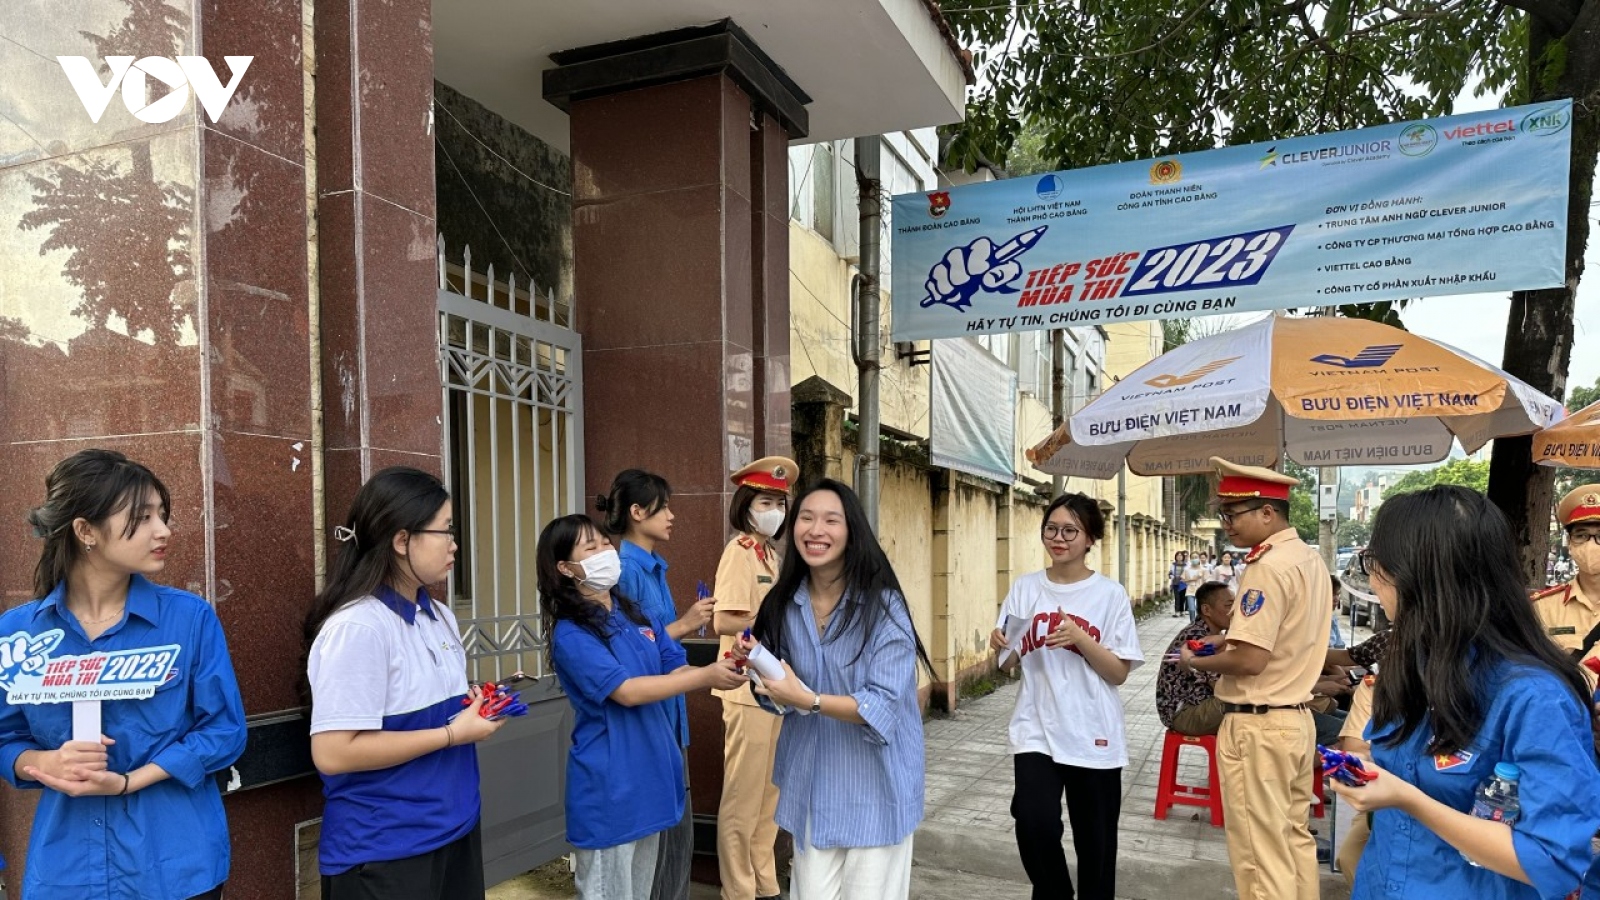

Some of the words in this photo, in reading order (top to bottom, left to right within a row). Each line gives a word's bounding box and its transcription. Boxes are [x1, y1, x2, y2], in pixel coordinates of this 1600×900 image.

[1443, 120, 1516, 141] viettel
[1529, 114, 1562, 129] XNK
[1154, 187, 1182, 197] THANH
[1047, 201, 1063, 211] VIỆT
[1065, 199, 1081, 208] NAM
[1117, 201, 1140, 211] CÔNG
[1142, 200, 1153, 208] AN
[1174, 195, 1193, 204] CAO
[1325, 205, 1347, 215] ĐƠN
[1049, 210, 1065, 220] CAO
[1325, 218, 1358, 229] TRUNG
[1359, 214, 1380, 225] TÂM
[1382, 213, 1403, 222] ANH
[1404, 209, 1428, 220] NGỮ
[1430, 206, 1467, 217] CLEVER
[1468, 202, 1506, 213] JUNIOR
[943, 220, 960, 229] CAO
[1325, 240, 1352, 250] CÔNG
[1354, 240, 1366, 248] TY
[1367, 238, 1381, 246] CP
[1382, 233, 1425, 246] THƯƠNG
[1427, 231, 1446, 241] MẠI
[1501, 223, 1523, 233] CAO
[1025, 258, 1082, 290] TIẾP
[1084, 251, 1142, 277] SỨC
[1129, 231, 1282, 292] 2023
[1324, 262, 1361, 272] VIETTEL
[1362, 259, 1383, 269] CAO
[1078, 277, 1126, 302] THI
[1324, 285, 1351, 295] CÔNG
[1353, 284, 1365, 292] TY
[966, 317, 995, 332] HÃY
[998, 315, 1018, 330] TỰ
[1020, 313, 1044, 328] TIN,
[1049, 307, 1103, 324] CHÚNG
[1105, 304, 1132, 319] TÔI
[1133, 303, 1149, 316] ĐI
[1152, 299, 1198, 314] CÙNG
[1201, 296, 1237, 311] BẠN
[1309, 368, 1388, 377] VIETNAM
[1393, 365, 1442, 374] POST
[1121, 385, 1187, 401] VIETNAM
[1191, 378, 1237, 390] POST
[1301, 397, 1341, 411] BƯU
[1346, 395, 1390, 412] ĐIỆN
[1393, 392, 1436, 411] VIỆT
[1438, 393, 1479, 407] NAM
[1089, 421, 1121, 436] BƯU
[1125, 413, 1160, 432] ĐIỆN
[1164, 407, 1201, 426] VIỆT
[1204, 403, 1242, 420] NAM
[1591, 442, 1600, 460] VI
[101, 651, 171, 681] 2023
[76, 672, 99, 685] THI
